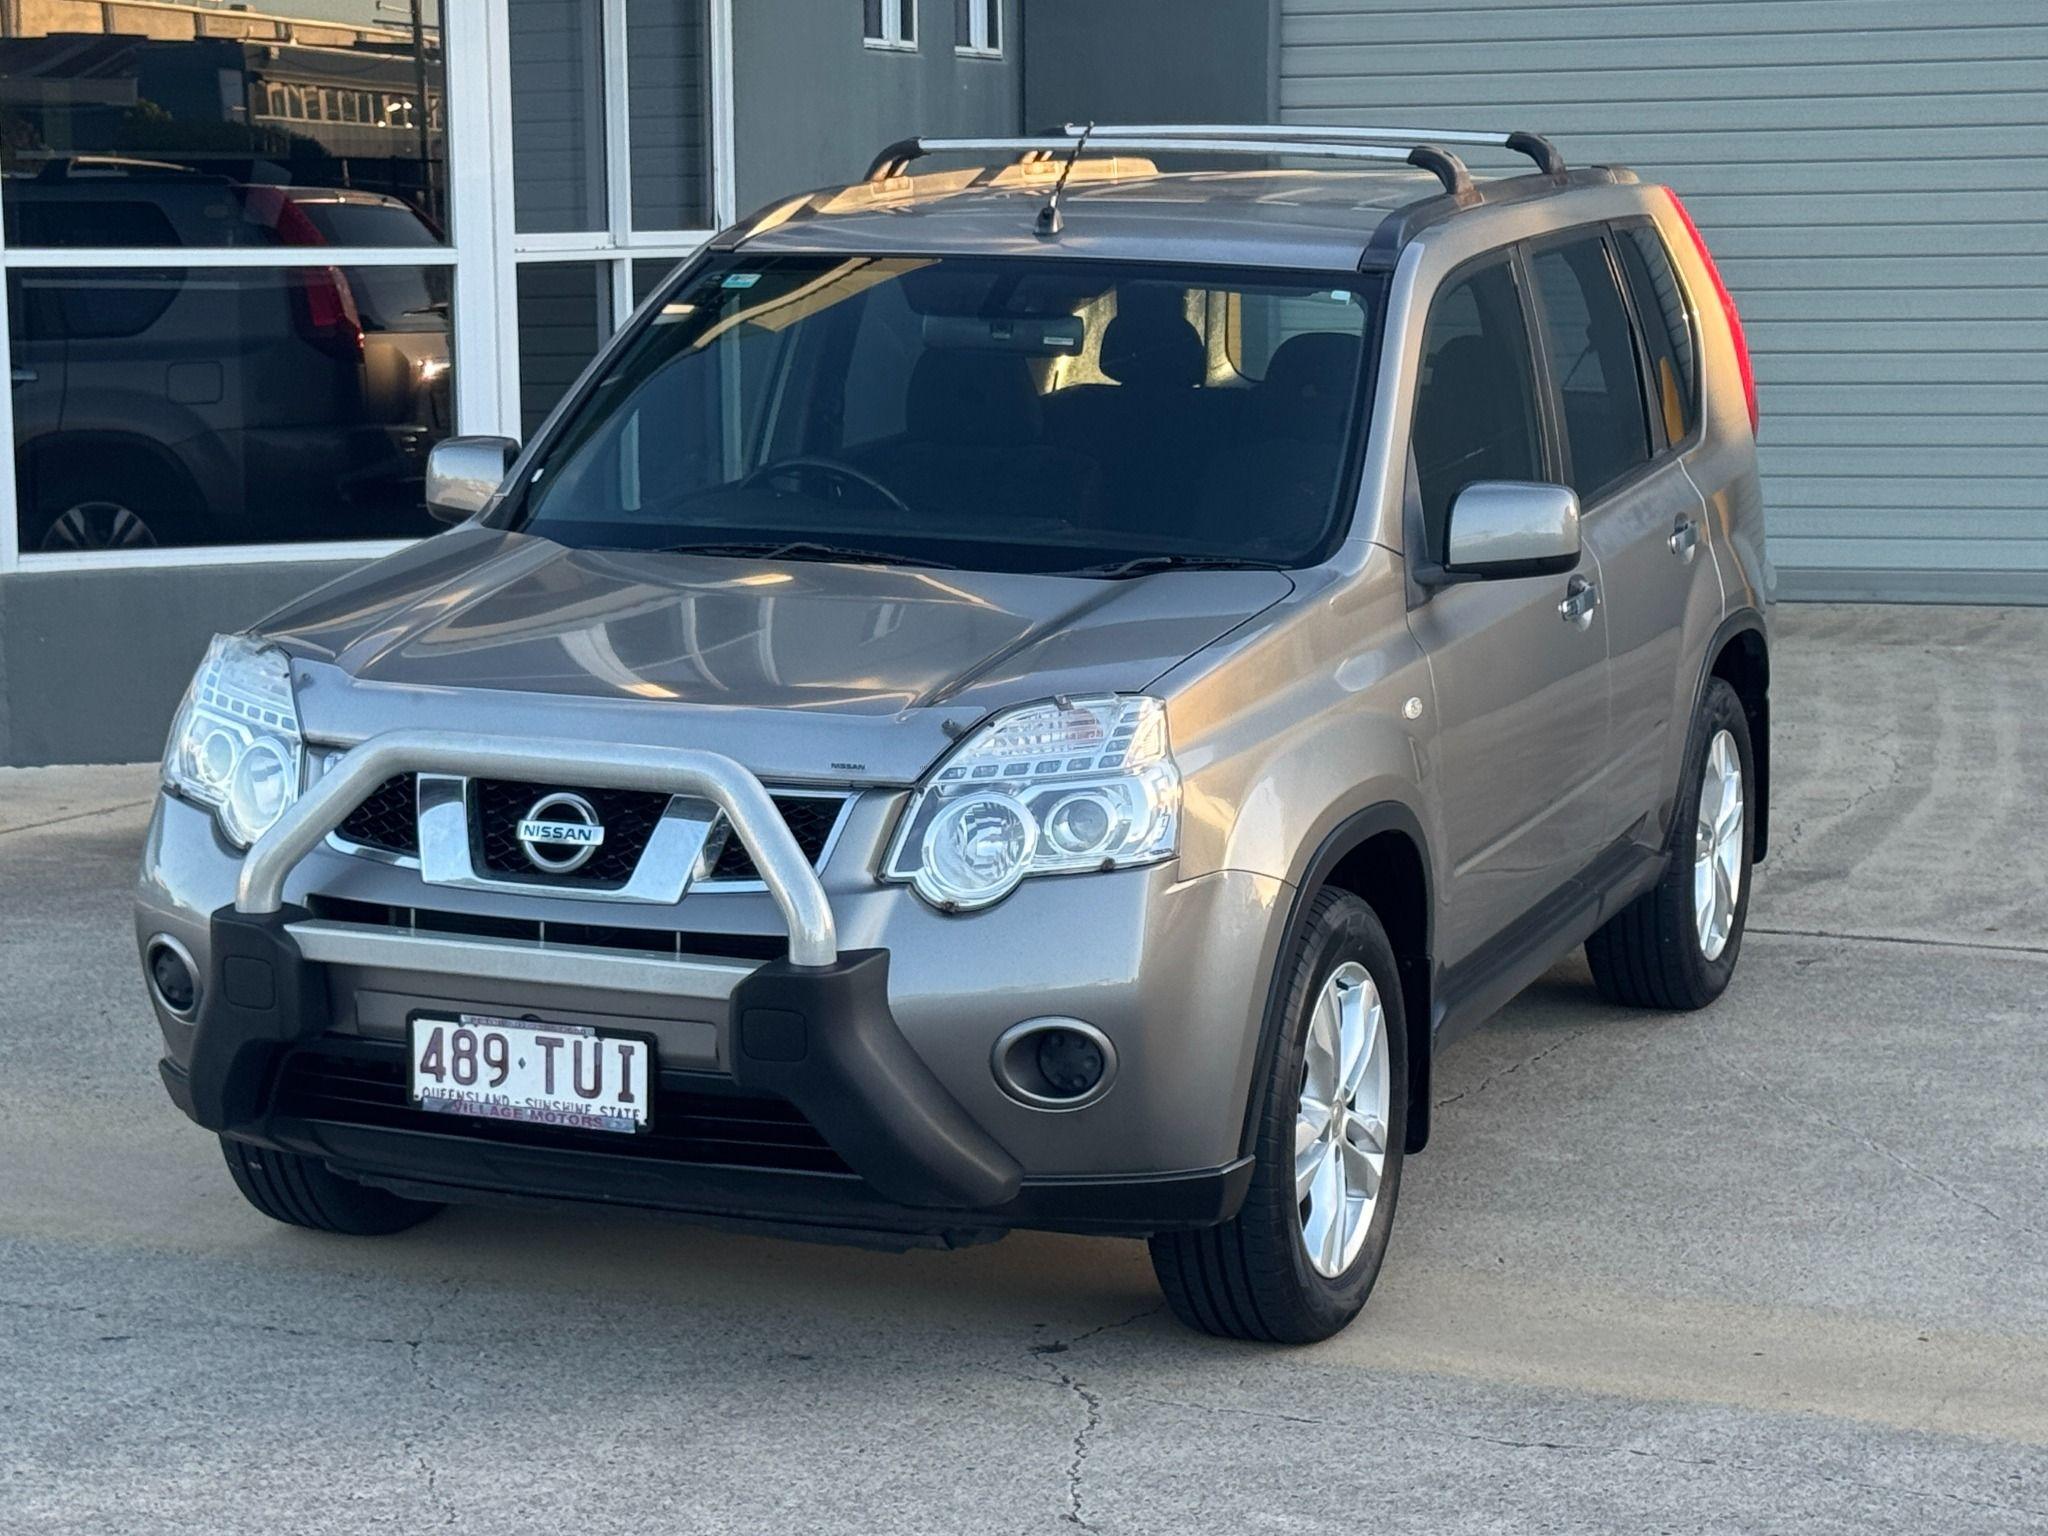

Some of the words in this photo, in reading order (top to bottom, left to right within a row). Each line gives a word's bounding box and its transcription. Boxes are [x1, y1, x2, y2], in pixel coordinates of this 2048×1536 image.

[523, 824, 593, 841] NISSAN
[420, 1027, 509, 1088] 489
[535, 1036, 635, 1103] TUI
[422, 1086, 510, 1106] QUEENSLAND
[525, 1097, 592, 1115] SUNSHINE
[599, 1105, 641, 1120] STATE
[453, 1101, 523, 1119] VILLAGE
[529, 1110, 603, 1128] MOTORS
